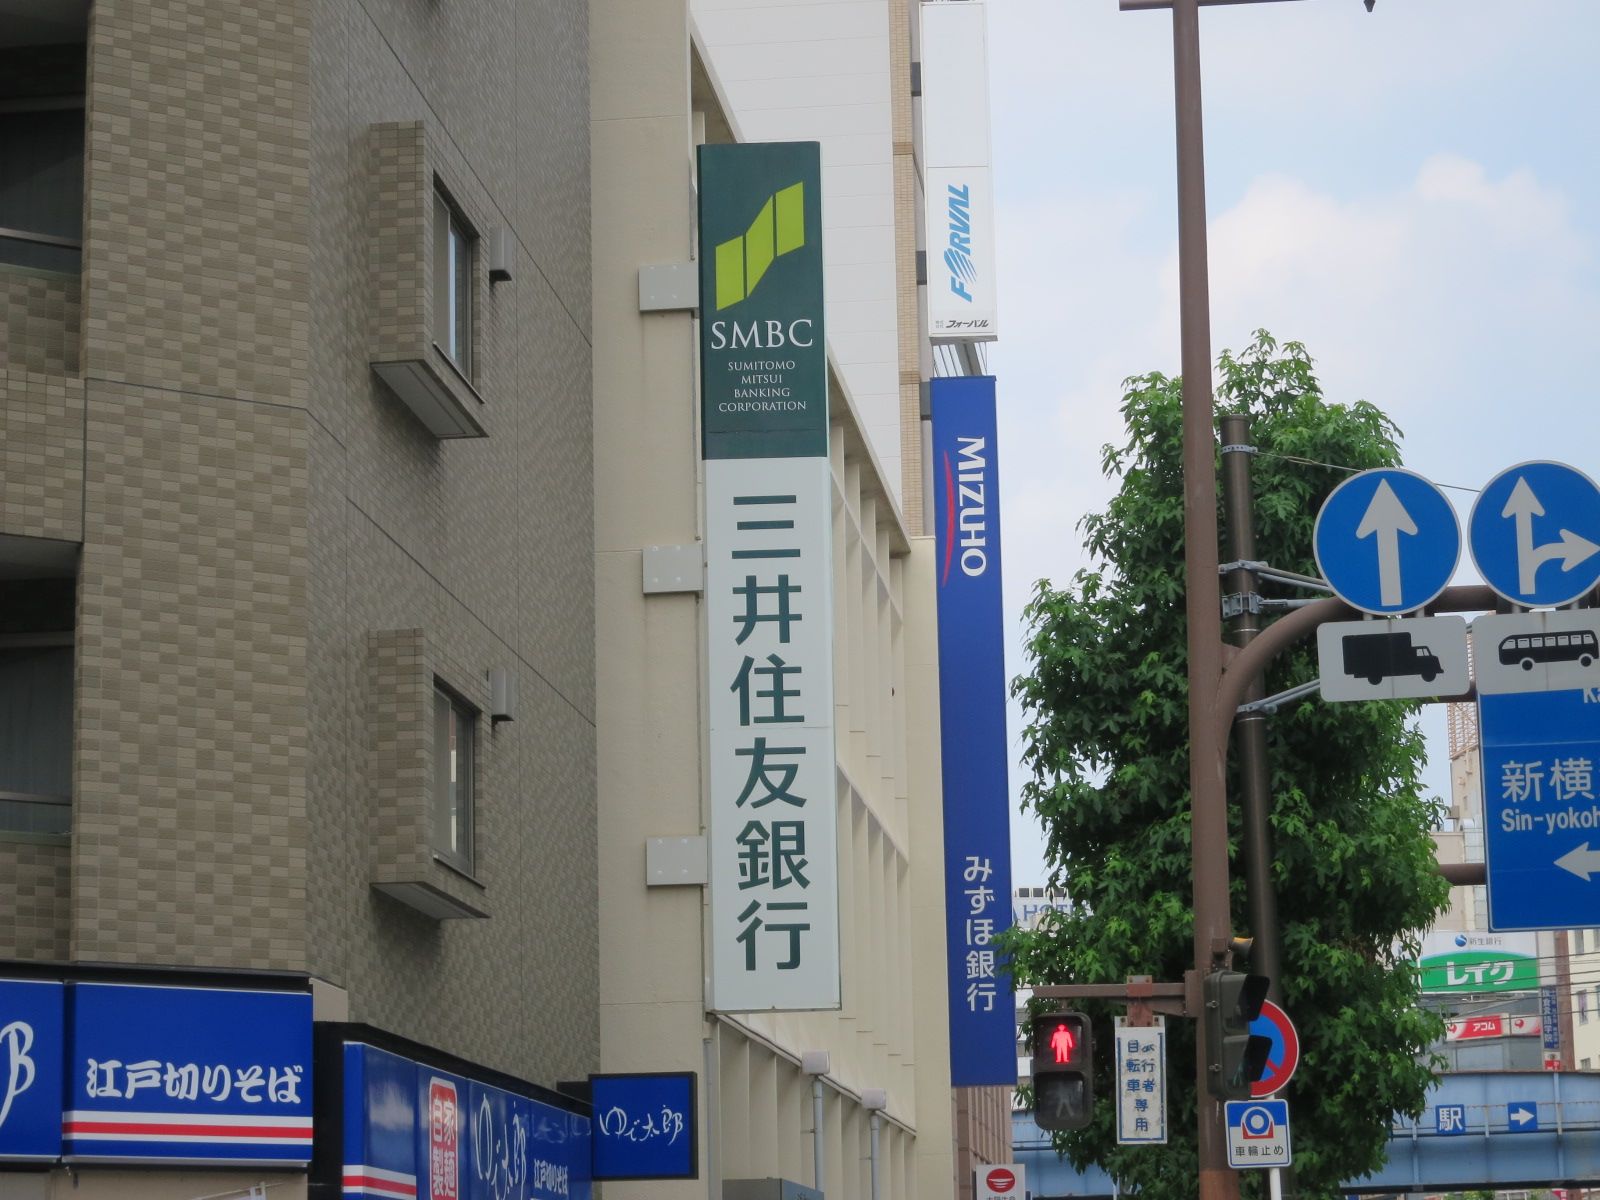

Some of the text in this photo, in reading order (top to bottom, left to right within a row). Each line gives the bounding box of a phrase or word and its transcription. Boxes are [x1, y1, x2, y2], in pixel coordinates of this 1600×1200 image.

[944, 183, 977, 303] FORVAL
[711, 319, 813, 350] SMBC
[945, 319, 989, 328] フォーバル
[728, 360, 796, 372] SUMITOMO
[741, 373, 783, 384] MITSUI
[734, 387, 790, 398] BANKING
[718, 400, 807, 413] CORPORATION
[957, 436, 987, 577] MIZUHO
[1582, 687, 1600, 704] K
[730, 494, 811, 972] 三井住友銀行
[1501, 757, 1600, 803] 新横
[963, 856, 997, 1012] みずほ銀行
[1446, 961, 1514, 986] レイク
[1472, 1021, 1496, 1032] アコム
[86, 1058, 303, 1104] 江戸切りそば
[599, 1104, 683, 1146] ゆで太郎
[1134, 1099, 1149, 1132] 専用
[1439, 1107, 1463, 1131] 駅
[1235, 1145, 1284, 1157] 車輪止め
